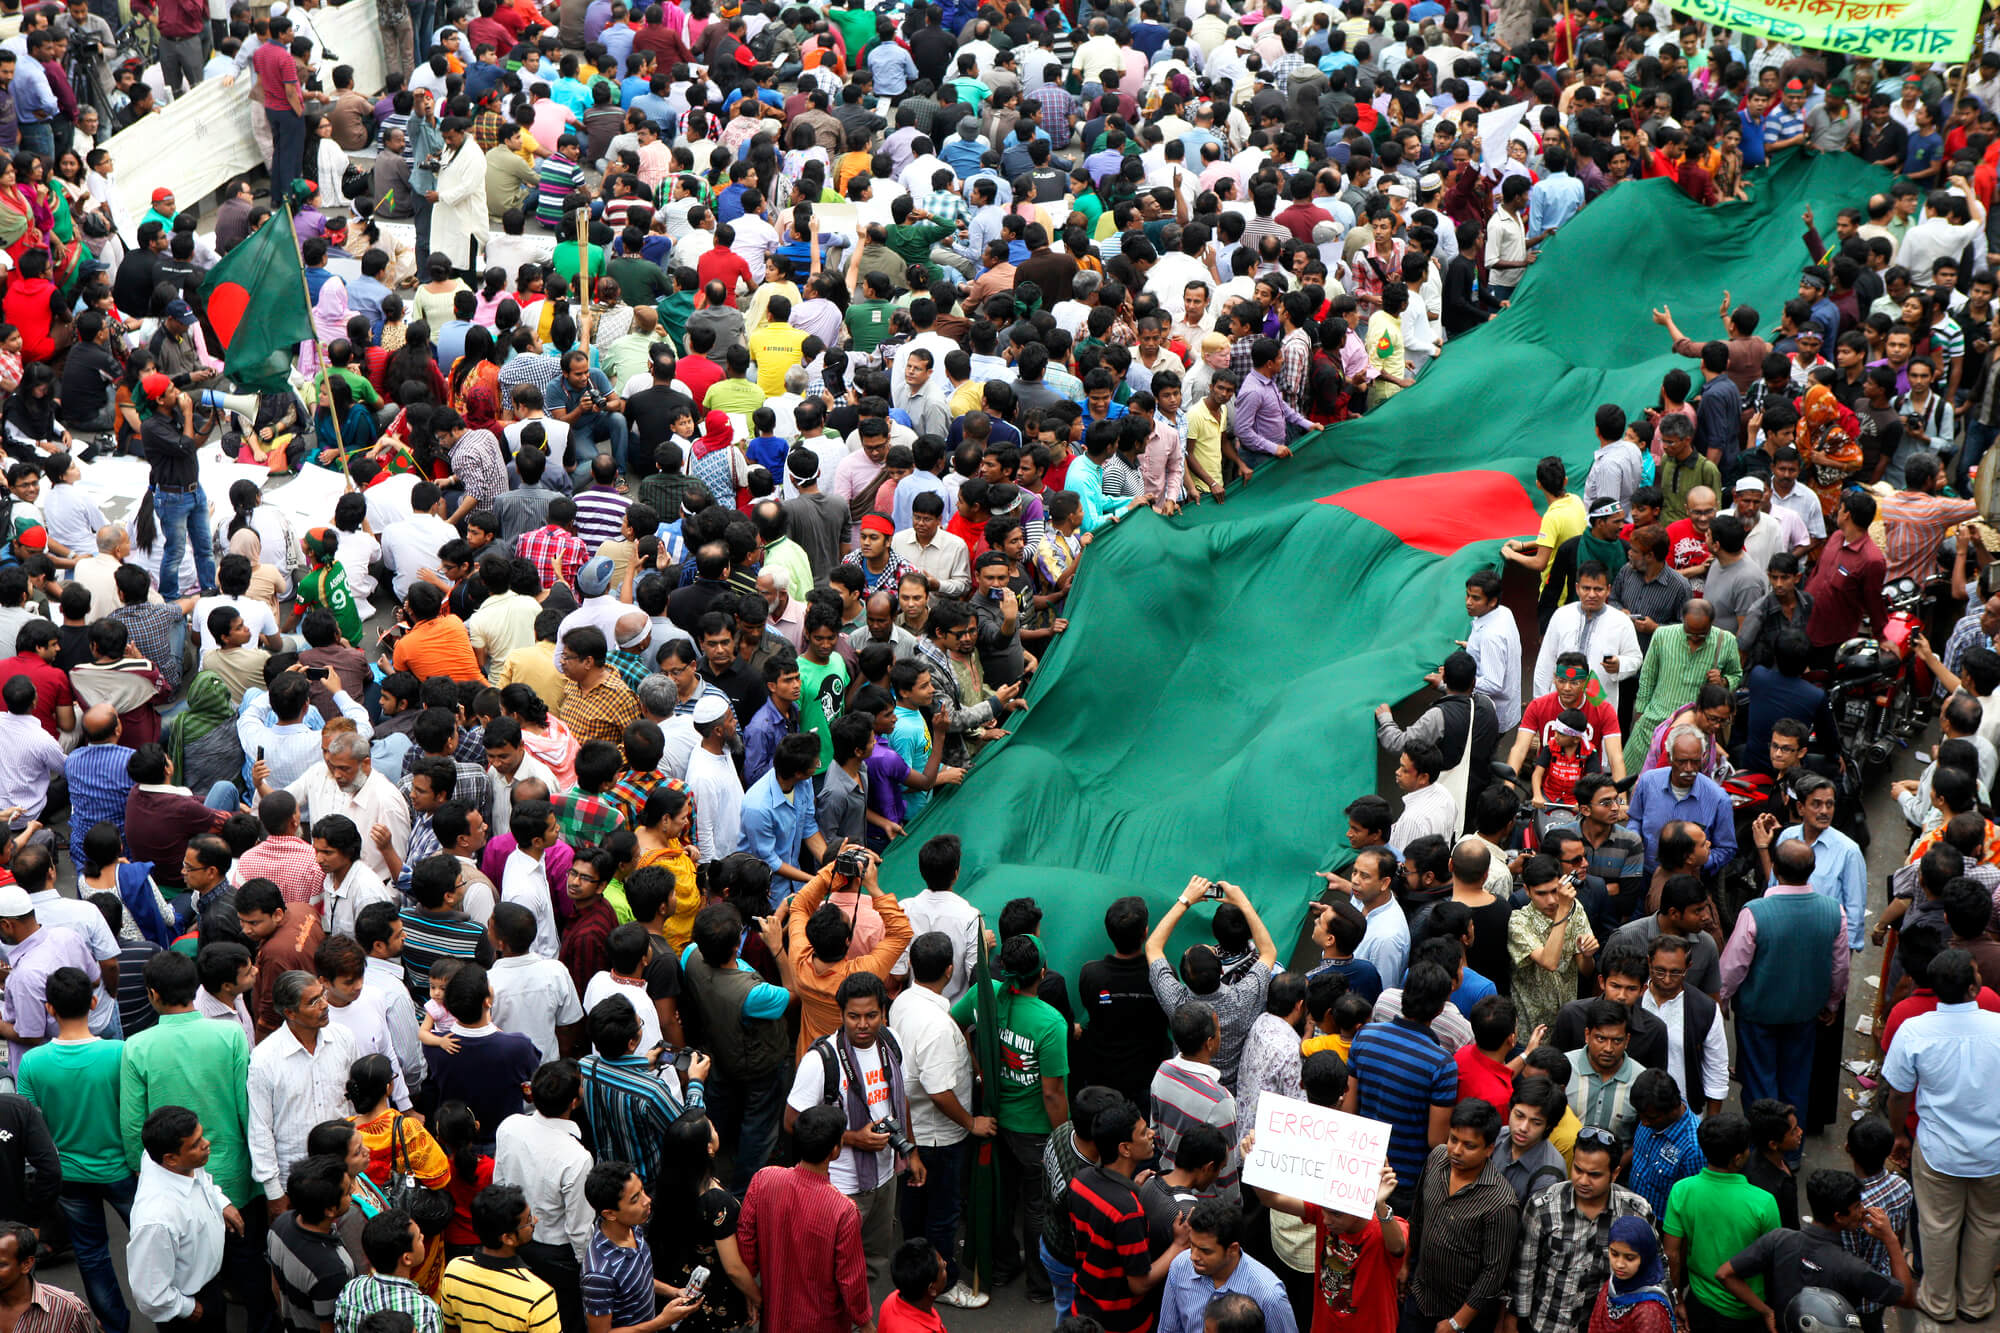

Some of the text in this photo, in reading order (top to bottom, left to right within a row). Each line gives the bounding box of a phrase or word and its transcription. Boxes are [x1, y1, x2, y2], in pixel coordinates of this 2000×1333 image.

[1015, 1033, 1035, 1054] WILL
[1268, 1110, 1380, 1151] ERROR 404
[1256, 1149, 1327, 1179] JUSTICE
[1336, 1154, 1377, 1180] NOT
[1329, 1180, 1376, 1205] FOUND
